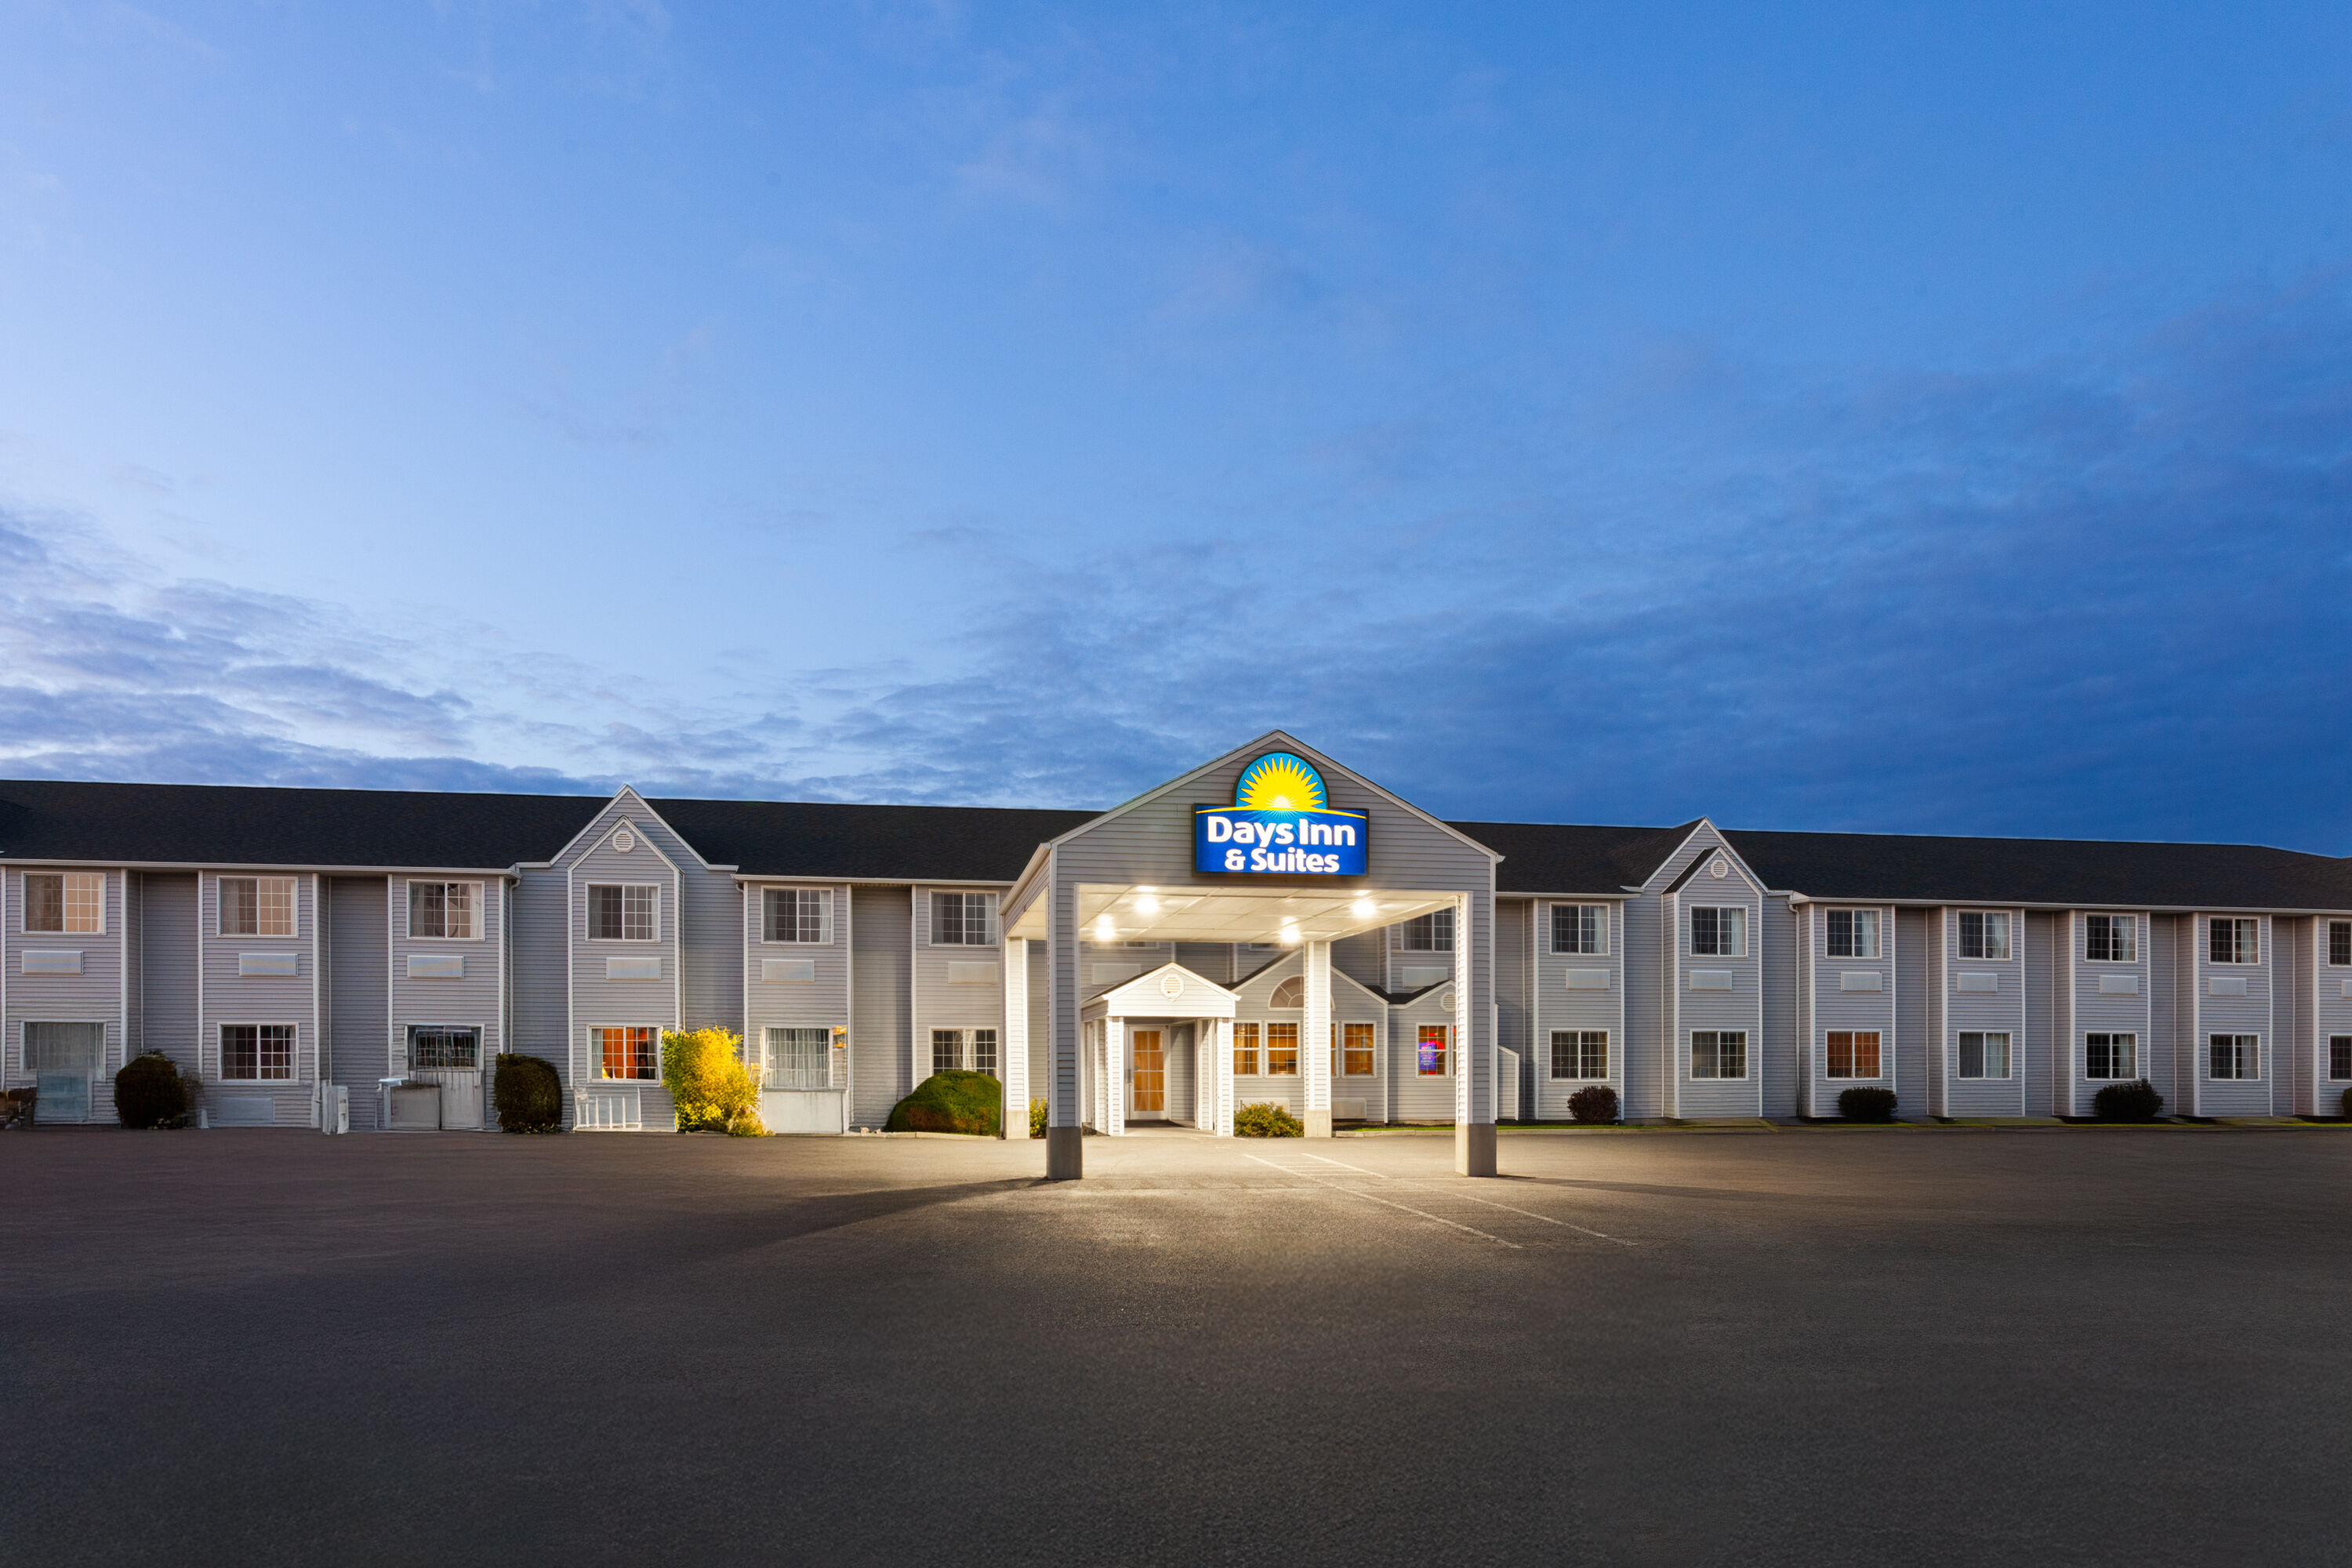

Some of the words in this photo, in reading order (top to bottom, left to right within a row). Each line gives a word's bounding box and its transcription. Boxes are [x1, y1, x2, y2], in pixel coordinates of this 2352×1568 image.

[1207, 815, 1294, 848] Days
[1299, 818, 1356, 846] Inn
[1225, 848, 1246, 871] &
[1250, 847, 1340, 873] Suites
